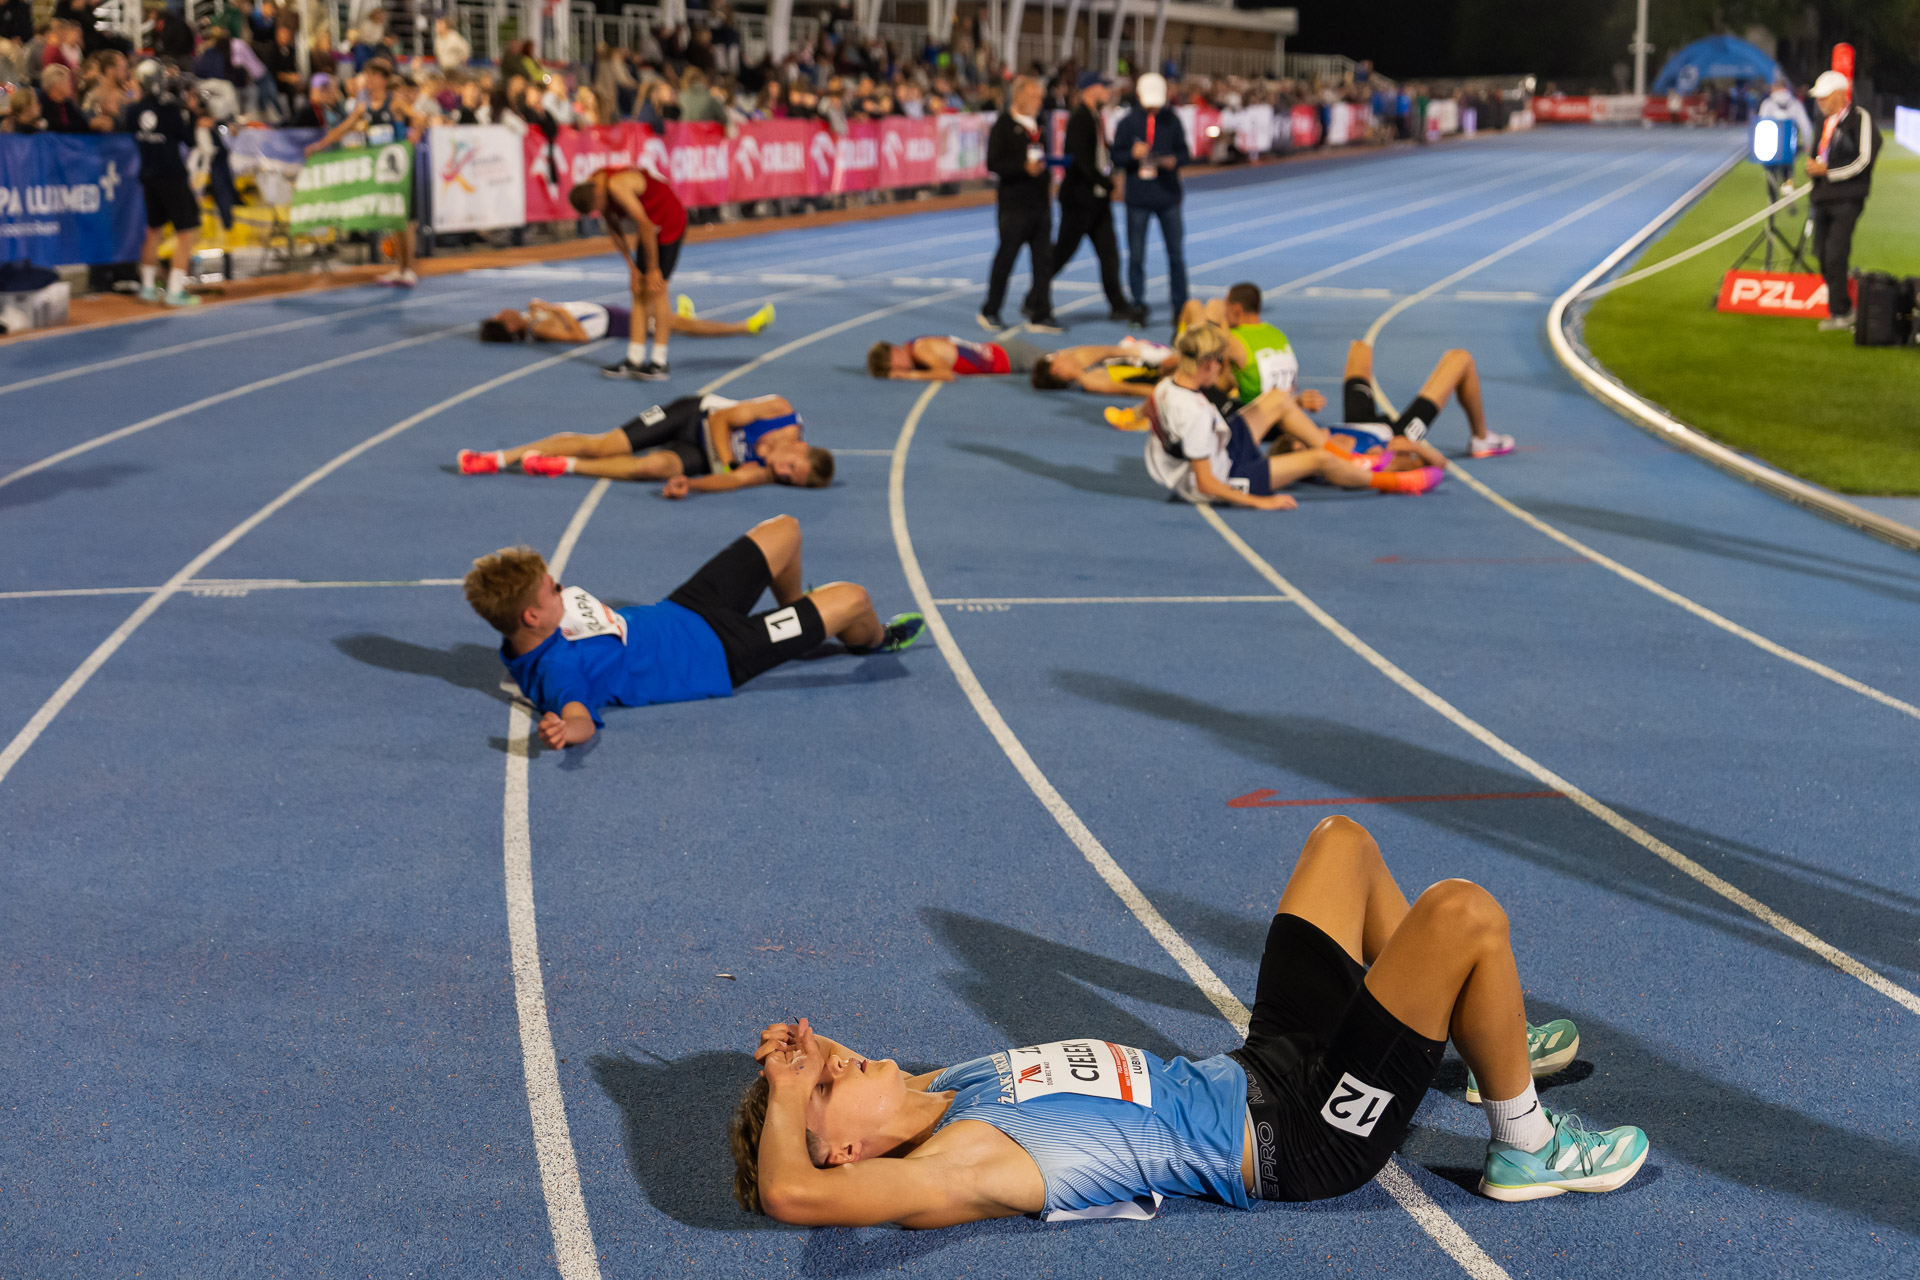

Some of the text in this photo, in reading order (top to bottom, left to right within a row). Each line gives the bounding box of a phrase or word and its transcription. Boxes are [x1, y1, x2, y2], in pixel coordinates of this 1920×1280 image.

[670, 145, 729, 183] ORLEN
[770, 616, 794, 630] 1
[1060, 1042, 1100, 1082] CIELEK
[1130, 1055, 1143, 1075] LUBIN
[997, 1073, 1015, 1104] ŻAK
[1328, 1081, 1381, 1128] 12
[1257, 1121, 1278, 1182] PRO
